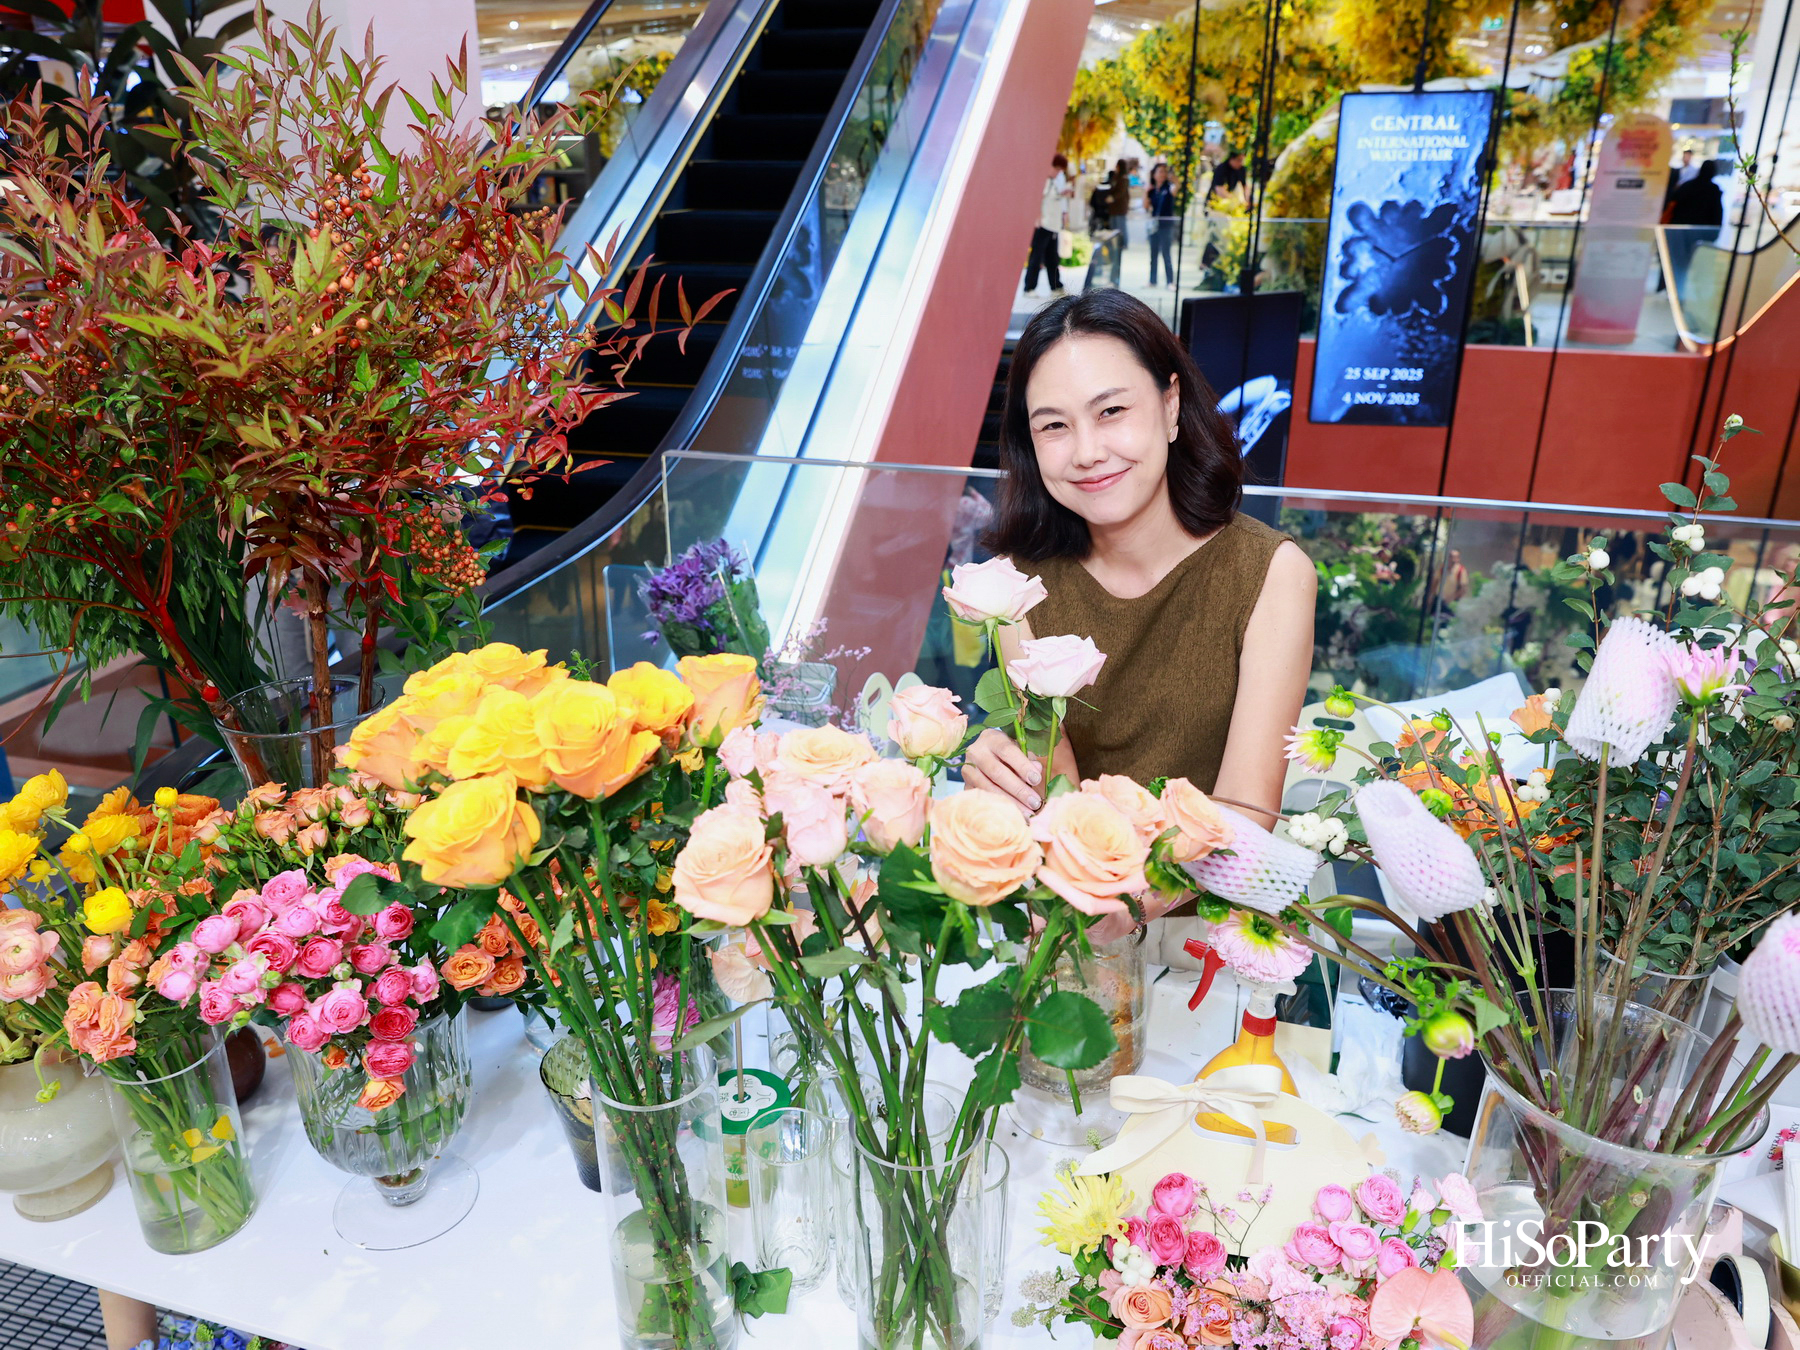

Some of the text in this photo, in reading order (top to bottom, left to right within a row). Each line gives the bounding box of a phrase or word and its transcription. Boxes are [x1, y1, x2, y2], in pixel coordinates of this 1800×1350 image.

[1371, 115, 1460, 131] CENTRAL
[1357, 135, 1469, 149] INTERNATIONAL
[1370, 148, 1453, 161] WATCH FAIR
[1344, 367, 1424, 381] 25 SEP 2025
[1342, 391, 1420, 405] 4 NOV 2025
